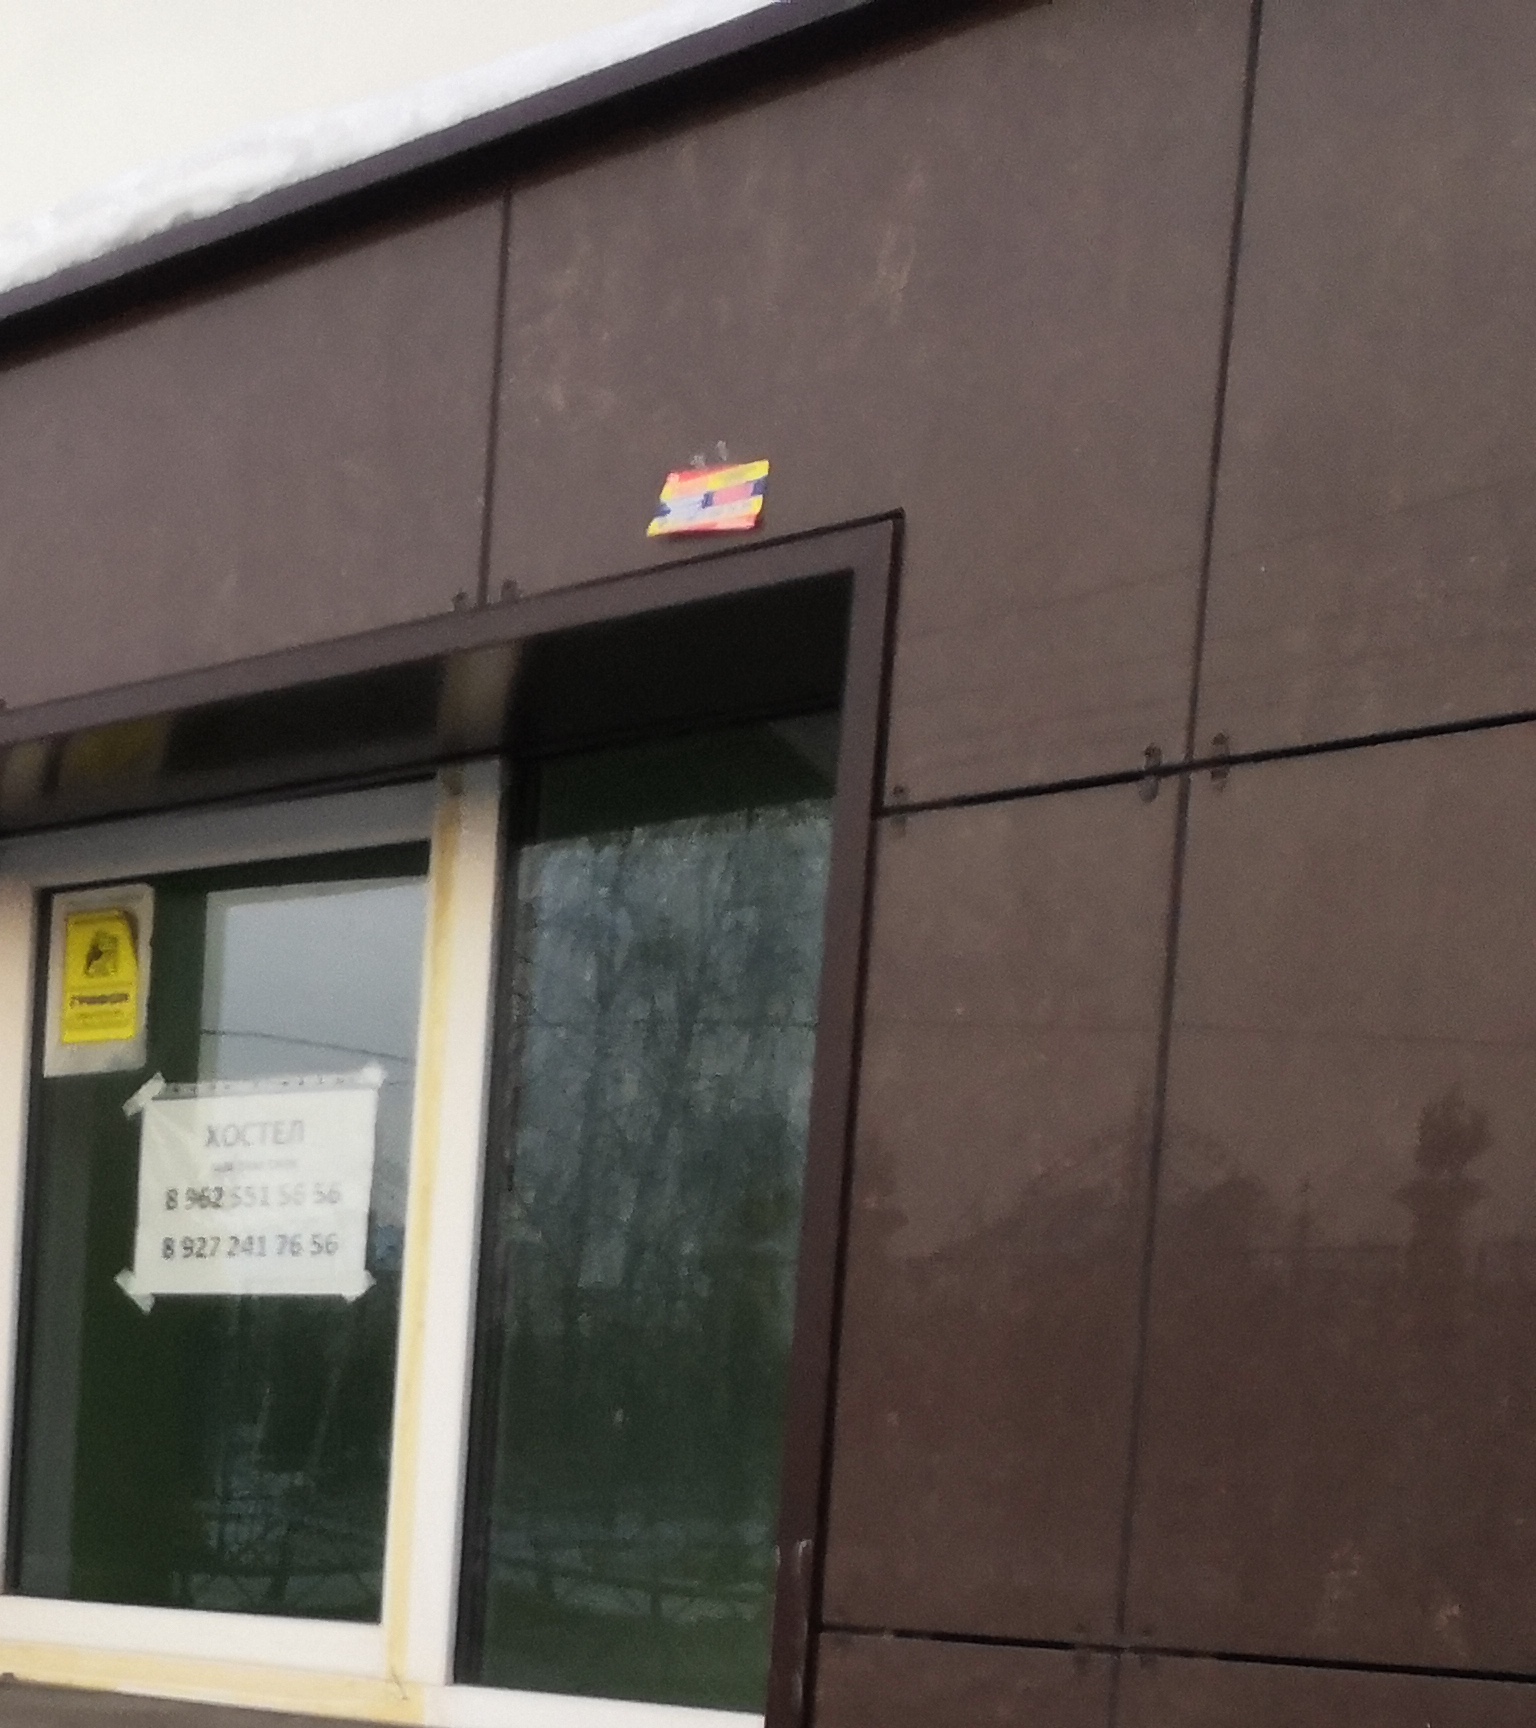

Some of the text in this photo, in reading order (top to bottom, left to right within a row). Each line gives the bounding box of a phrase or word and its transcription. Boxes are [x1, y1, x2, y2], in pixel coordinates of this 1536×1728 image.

[204, 1119, 305, 1148] ХОСТЕЛ
[165, 1187, 179, 1211] 8
[184, 1185, 224, 1211] 962
[161, 1232, 340, 1260] 8 927 241 76 56
